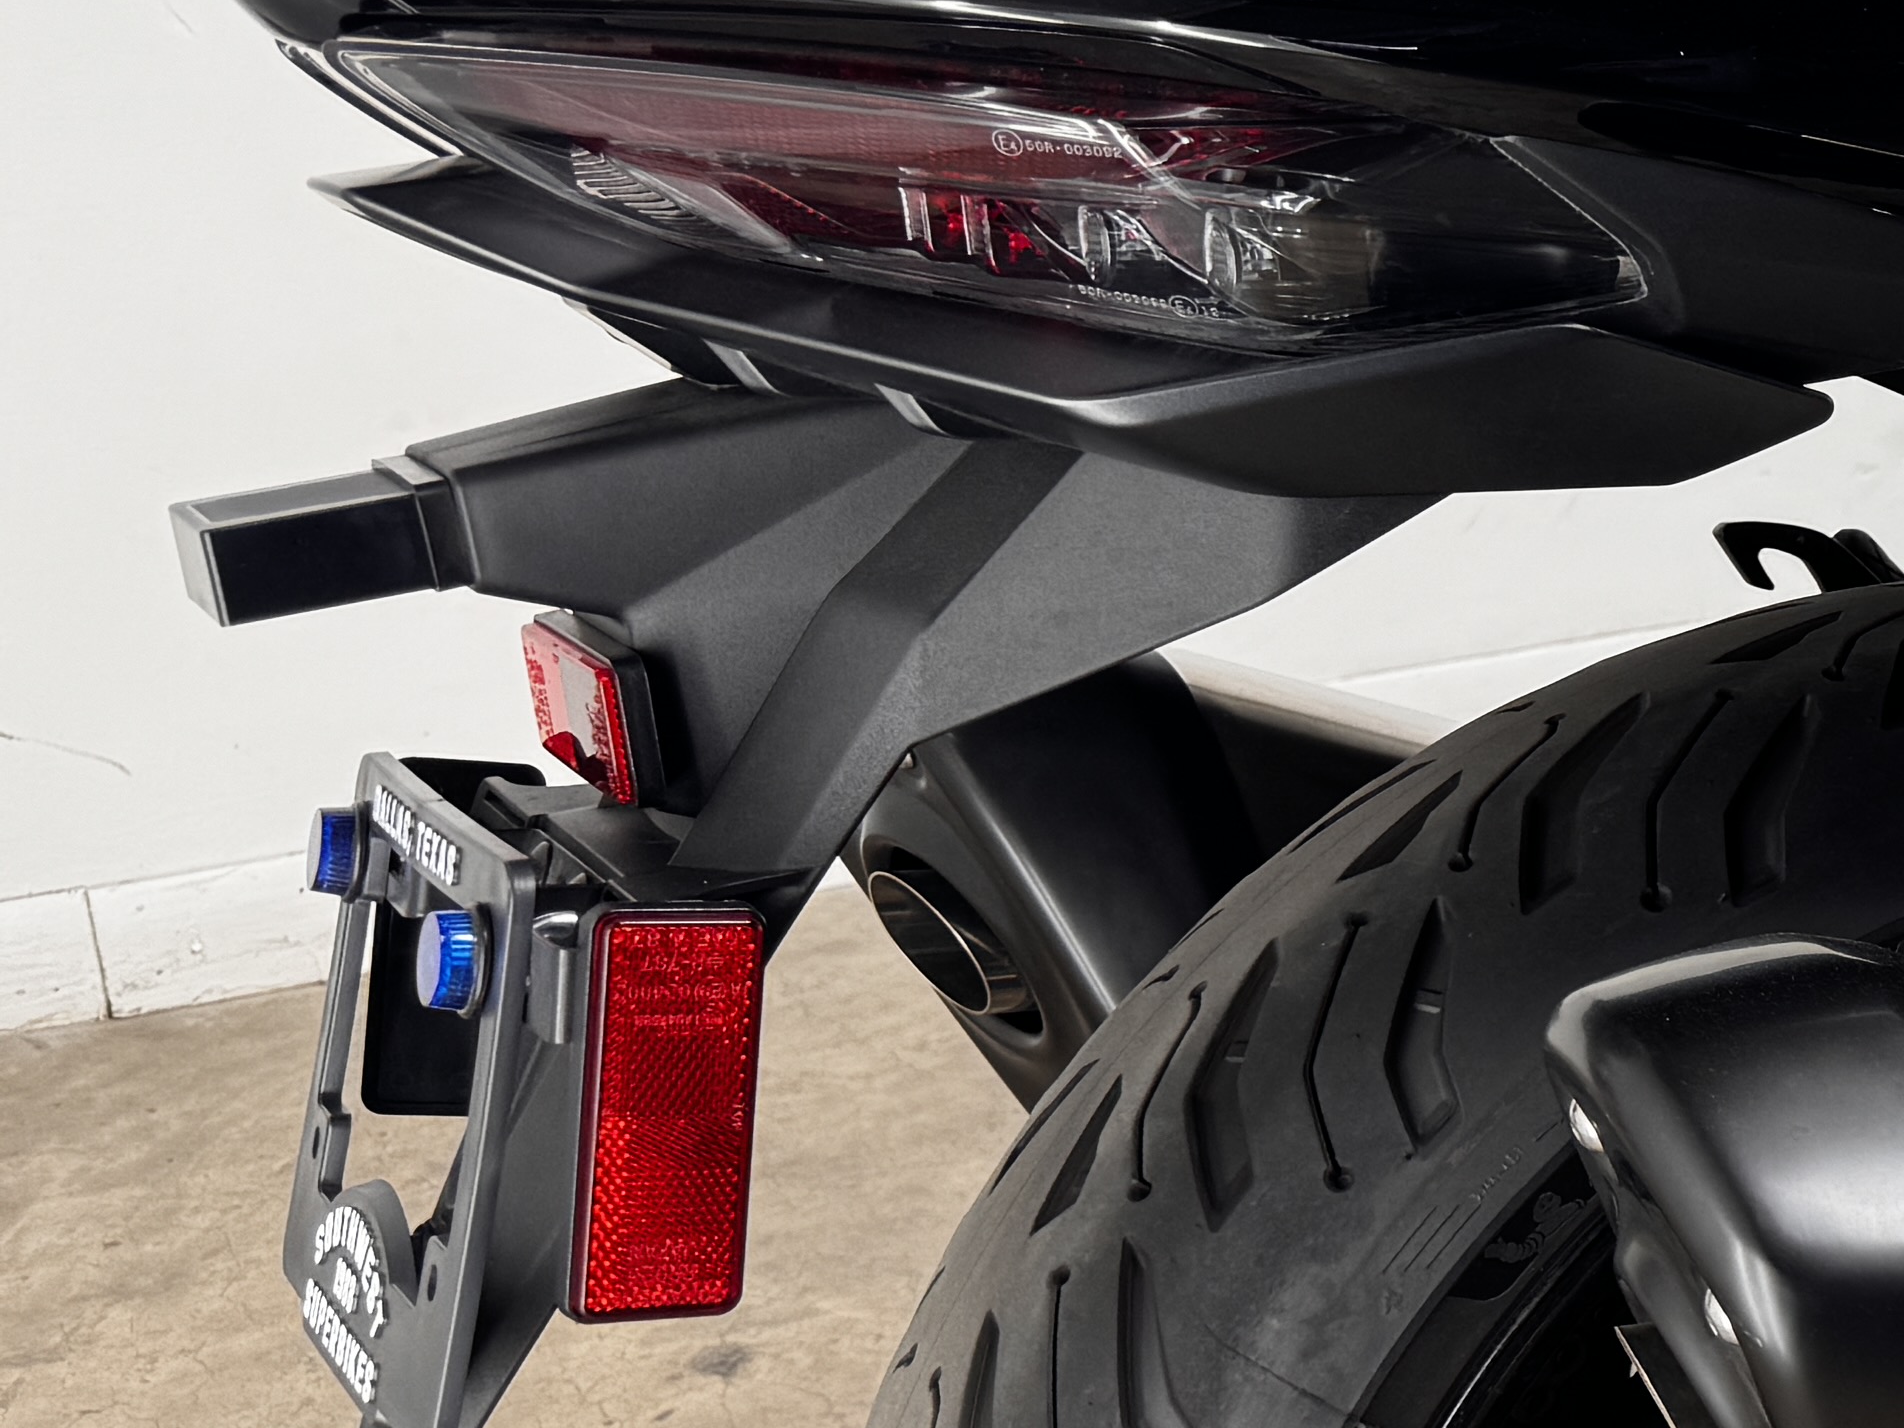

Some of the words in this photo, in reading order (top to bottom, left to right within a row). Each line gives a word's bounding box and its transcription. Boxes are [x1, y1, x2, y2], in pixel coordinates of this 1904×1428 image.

[415, 820, 461, 886] TEXAS
[314, 1206, 386, 1338] SOUTHWEST
[303, 1278, 380, 1404] SUPERBIKES
